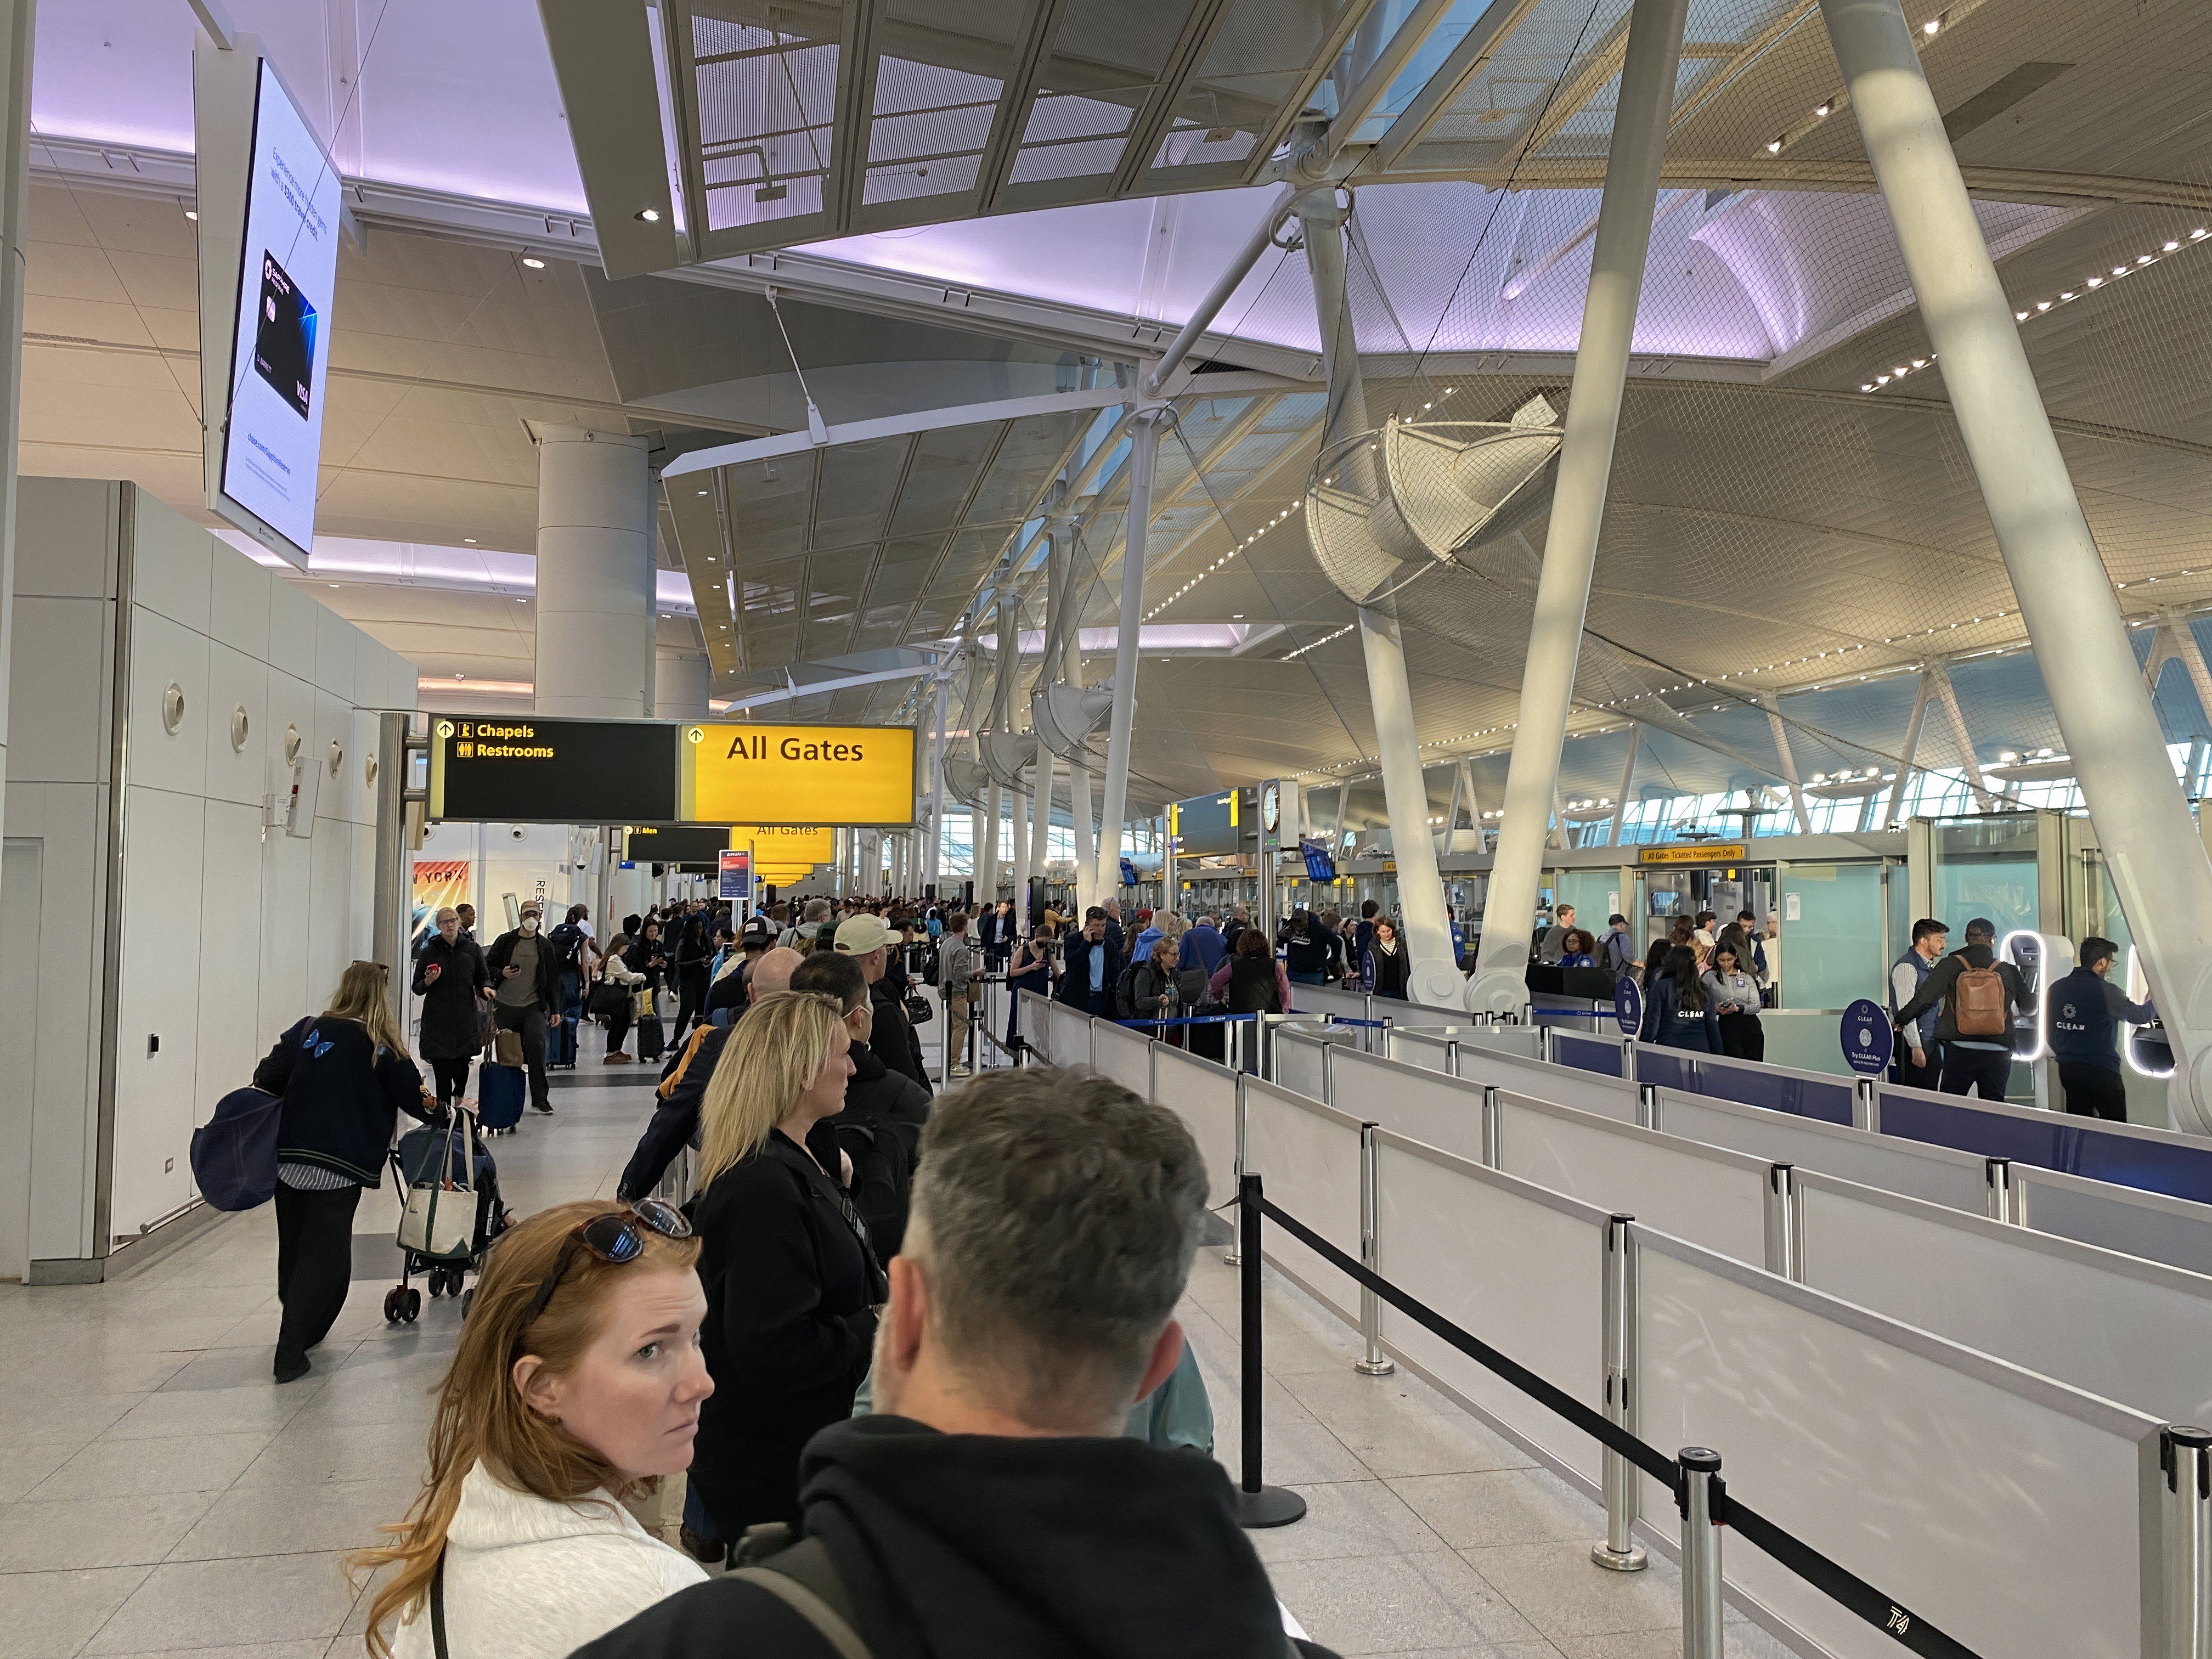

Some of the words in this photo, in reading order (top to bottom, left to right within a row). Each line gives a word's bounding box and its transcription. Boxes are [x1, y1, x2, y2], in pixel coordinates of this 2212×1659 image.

[297, 380, 308, 405] VISA
[477, 724, 534, 740] Chapels
[477, 744, 554, 758] Restrooms
[726, 735, 766, 760] All
[780, 737, 864, 761] Gates
[757, 827, 774, 835] All
[781, 827, 818, 836] Gates
[1656, 851, 1669, 860] Gates
[1672, 850, 1692, 859] Ticketed
[1693, 850, 1722, 860] Passengers
[1723, 849, 1736, 859] Only
[2056, 1022, 2085, 1030] CLEAR
[1887, 1605, 1910, 1635] T4
